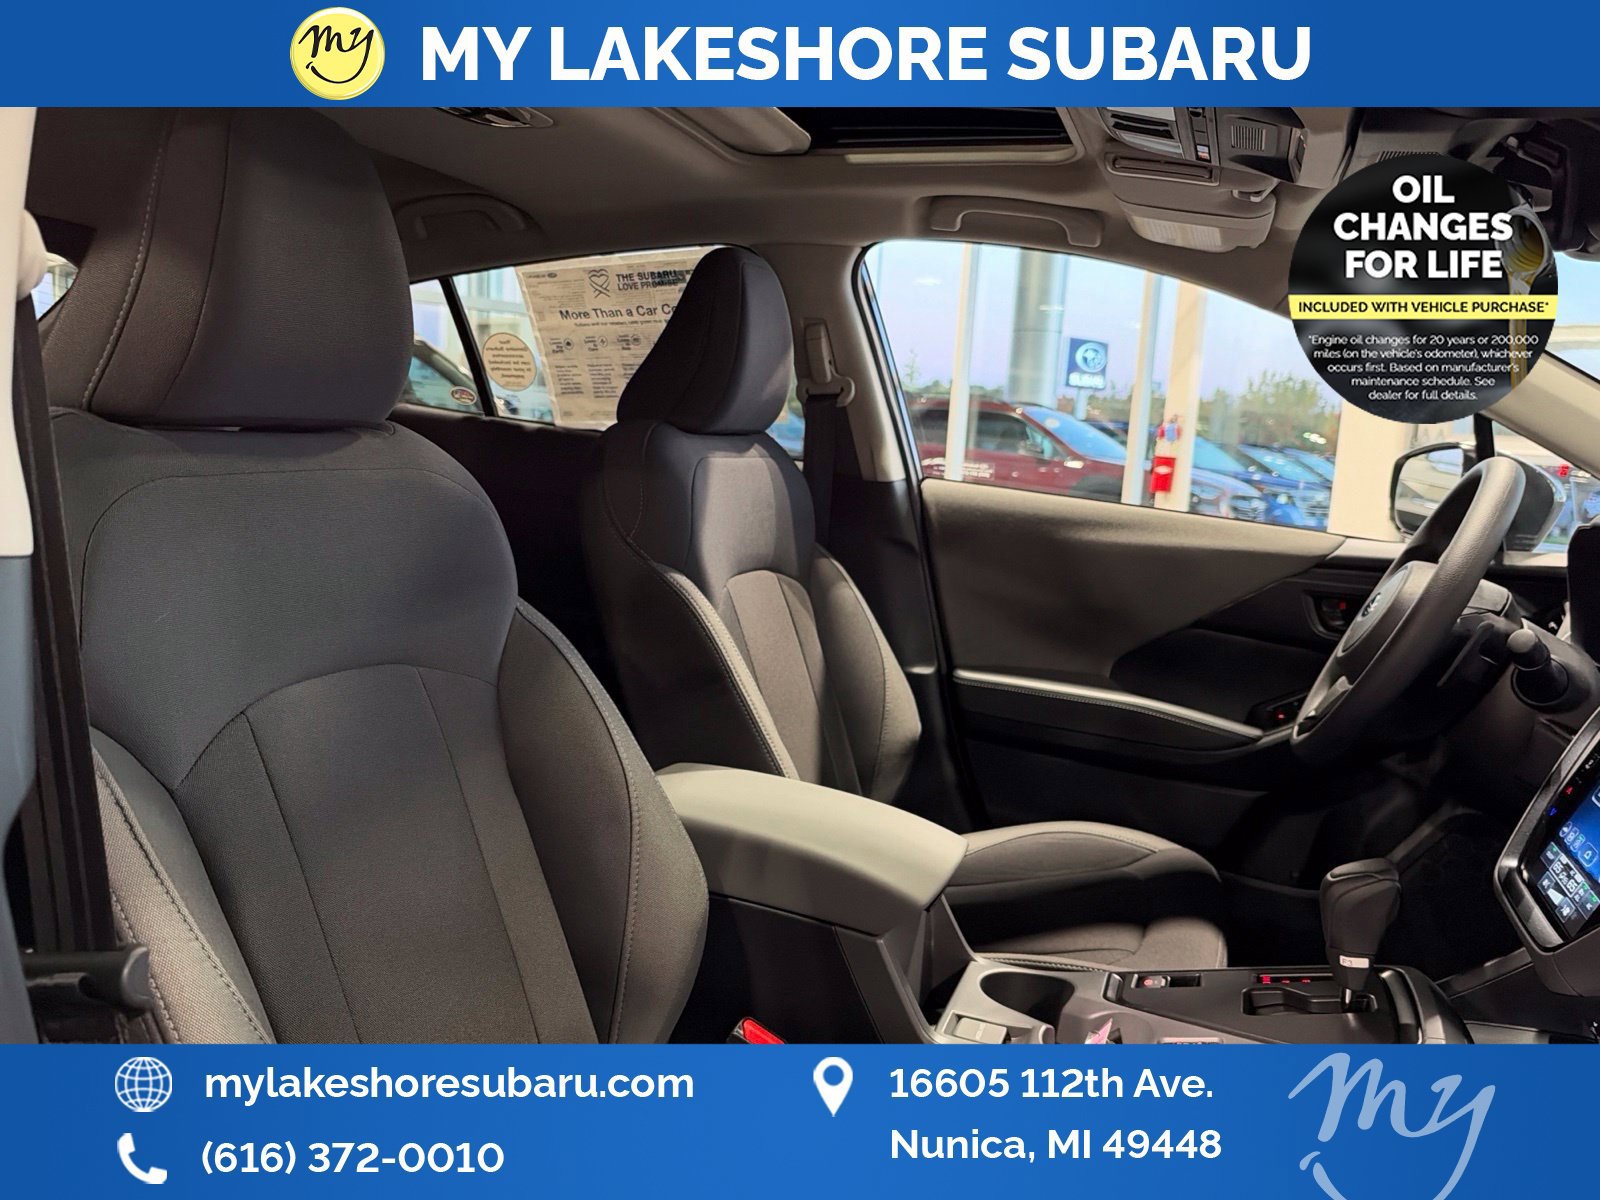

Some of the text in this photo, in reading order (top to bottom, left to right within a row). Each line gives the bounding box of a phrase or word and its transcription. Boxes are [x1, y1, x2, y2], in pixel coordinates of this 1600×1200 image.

[616, 270, 677, 282] THE SUBARU
[617, 282, 640, 291] LOVE
[559, 309, 590, 321] More
[592, 307, 623, 318] Than
[627, 308, 634, 317] a
[636, 305, 658, 317] Car
